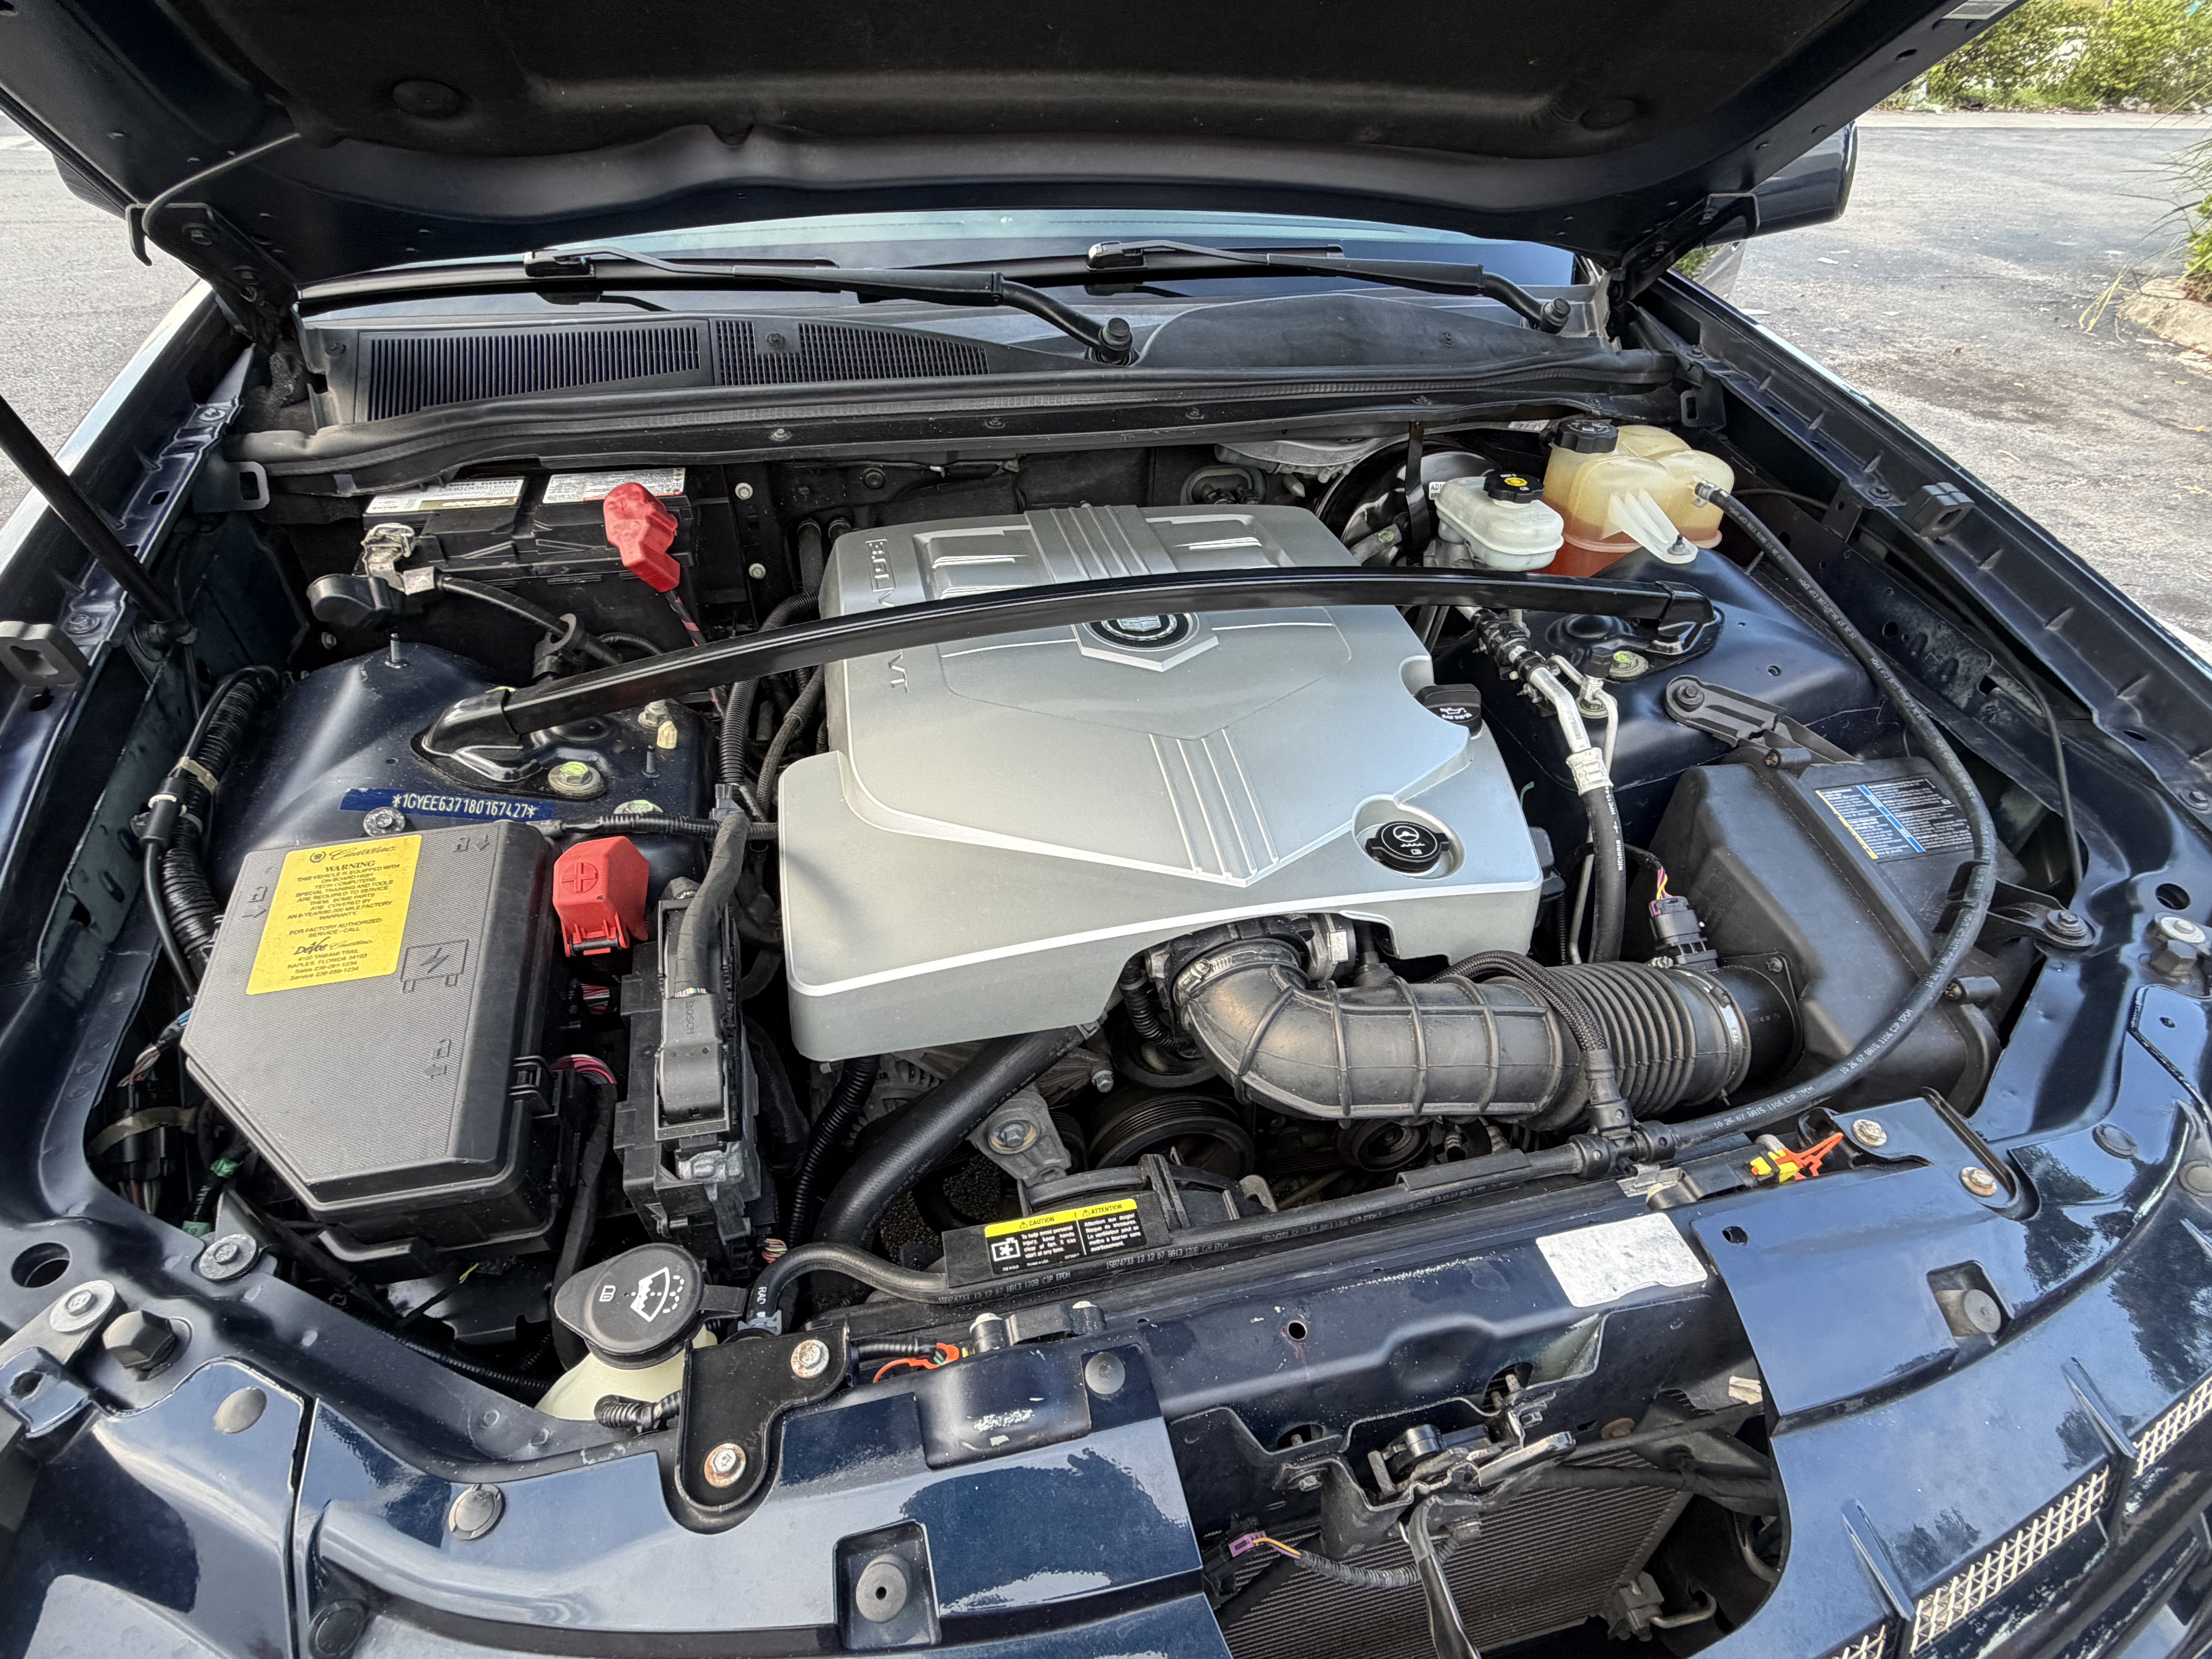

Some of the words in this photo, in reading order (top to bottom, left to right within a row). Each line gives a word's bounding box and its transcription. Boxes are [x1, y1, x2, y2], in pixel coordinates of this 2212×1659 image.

[325, 860, 376, 872] WARNING
[313, 891, 348, 900] REQUIRED
[327, 900, 361, 908] COVERED
[305, 924, 337, 933] FACTORY
[338, 918, 381, 928] AUTHORIZED
[308, 929, 339, 938] SERVICE
[292, 936, 331, 955] DeVoe
[318, 956, 347, 964] FLORIDA
[685, 1001, 694, 1034] BOSCH
[1714, 1121, 1723, 1129] 10
[1091, 1204, 1123, 1214] ATTENTION
[1029, 1216, 1054, 1226] CAUTION
[1137, 1255, 1144, 1263] 12
[1157, 1251, 1164, 1259] 07
[757, 1286, 767, 1305] RAD
